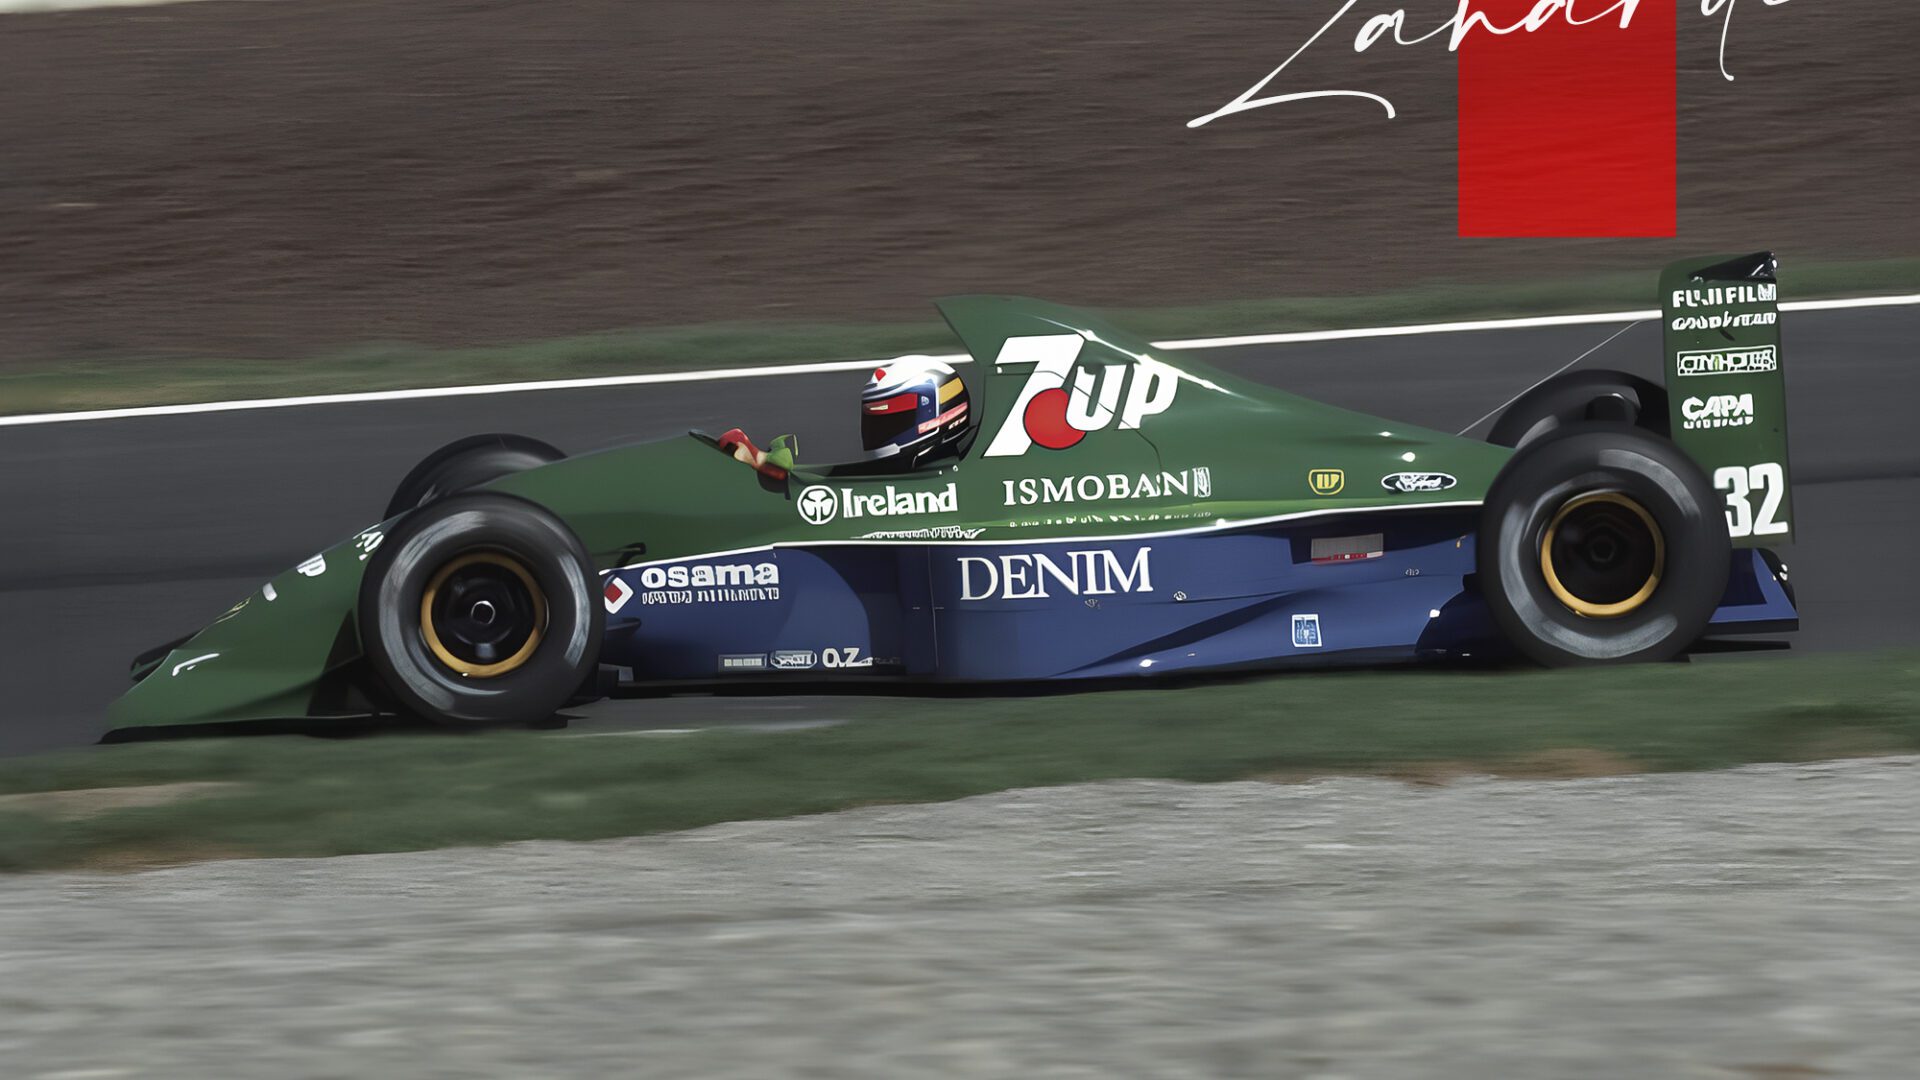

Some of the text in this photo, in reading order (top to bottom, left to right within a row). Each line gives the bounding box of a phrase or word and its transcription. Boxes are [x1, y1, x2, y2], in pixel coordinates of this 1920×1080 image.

[841, 482, 958, 518] Ireland
[1713, 462, 1789, 538] 32
[956, 547, 1154, 600] DENIM
